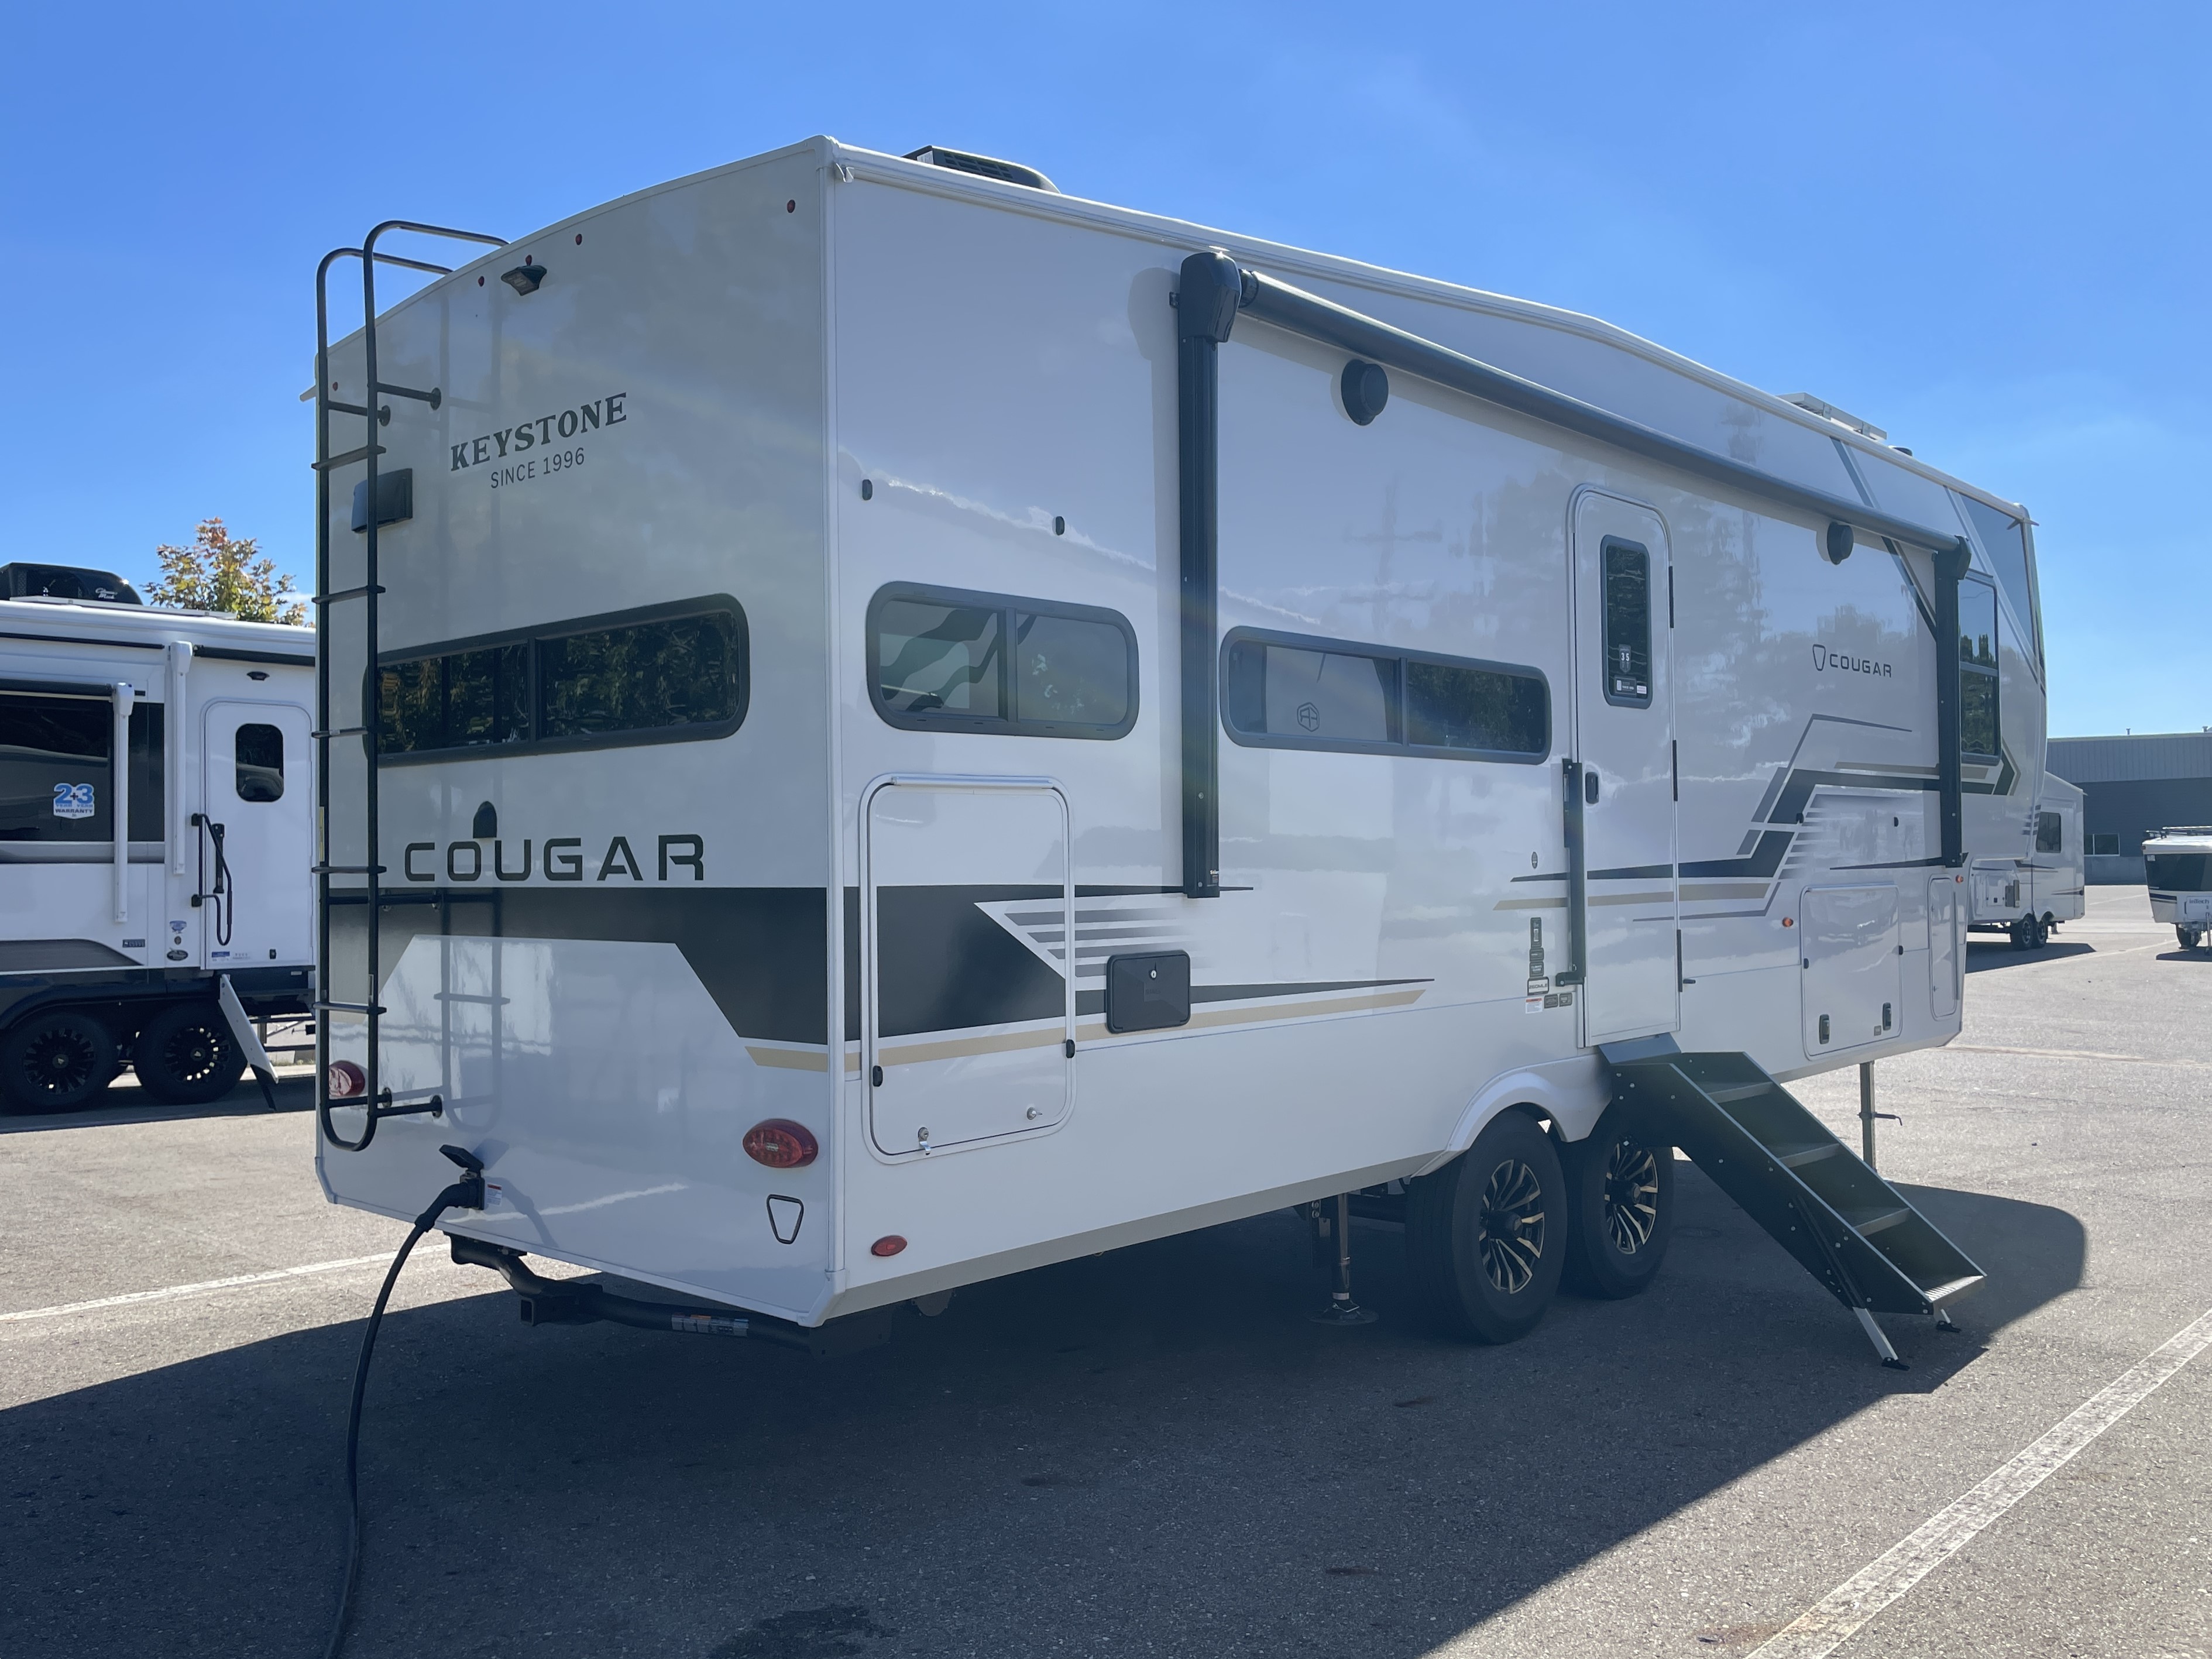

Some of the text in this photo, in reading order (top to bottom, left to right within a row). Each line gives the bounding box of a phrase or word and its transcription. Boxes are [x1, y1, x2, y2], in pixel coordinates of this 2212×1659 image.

[450, 391, 627, 472] KEYSTONE
[490, 446, 585, 489] SINCE 1996
[1829, 653, 1892, 678] COUGAR
[404, 833, 704, 882] COUGAR
